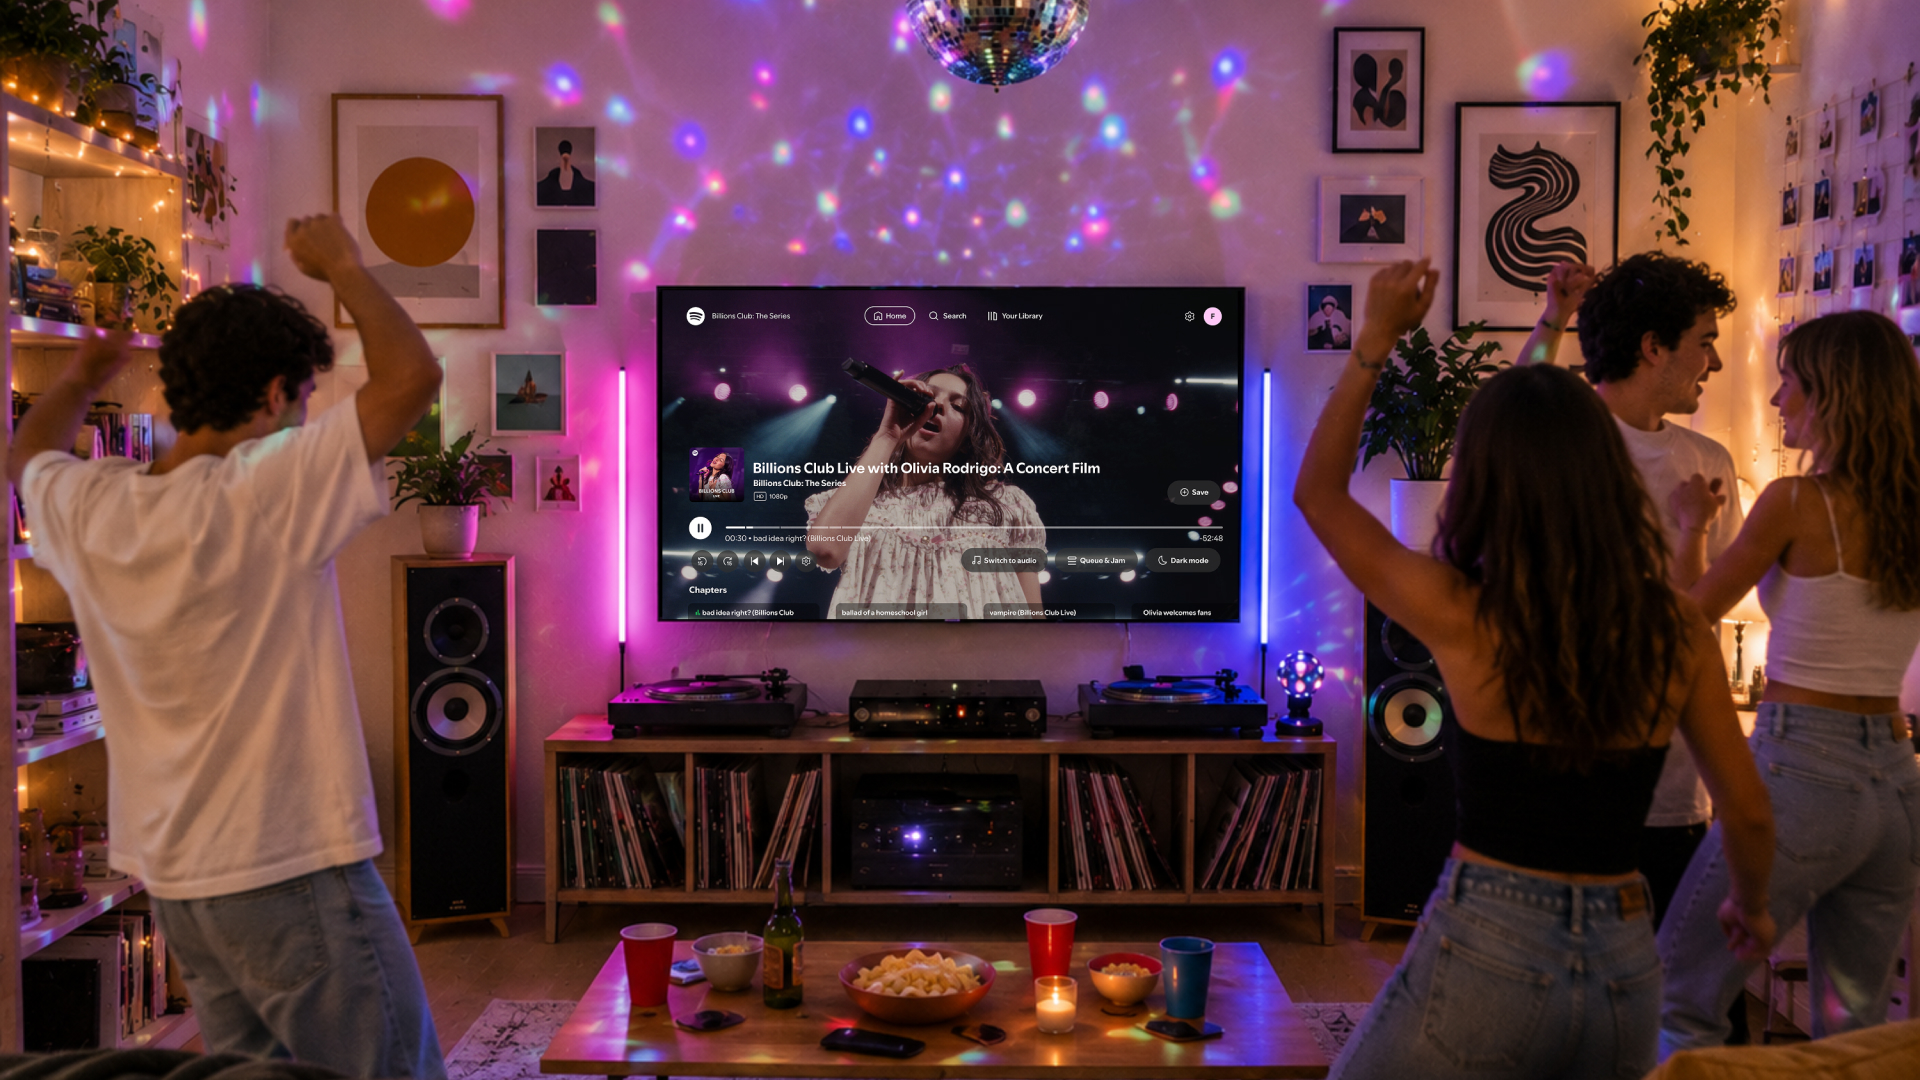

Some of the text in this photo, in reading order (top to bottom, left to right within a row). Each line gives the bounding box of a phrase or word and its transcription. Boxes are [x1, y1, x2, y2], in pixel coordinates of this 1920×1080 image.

[711, 312, 791, 320] Billions Club: The Series
[885, 312, 907, 320] Home
[942, 312, 967, 320] Search
[1002, 312, 1043, 322] Your Library
[753, 462, 1101, 477] Billions Club Live with Olivia Rodrigo: A Concert Film
[753, 479, 847, 487] Billions Club: The Series
[724, 534, 871, 544] 00:30 bad idea right? (Billions Club Live)
[688, 586, 728, 595] Chapters
[731, 609, 752, 618] right?
[752, 609, 778, 617] (Billions
[916, 609, 928, 618] girl
[990, 609, 1016, 618] vampire
[1017, 609, 1044, 617] (Billions
[1060, 609, 1077, 617] Live)
